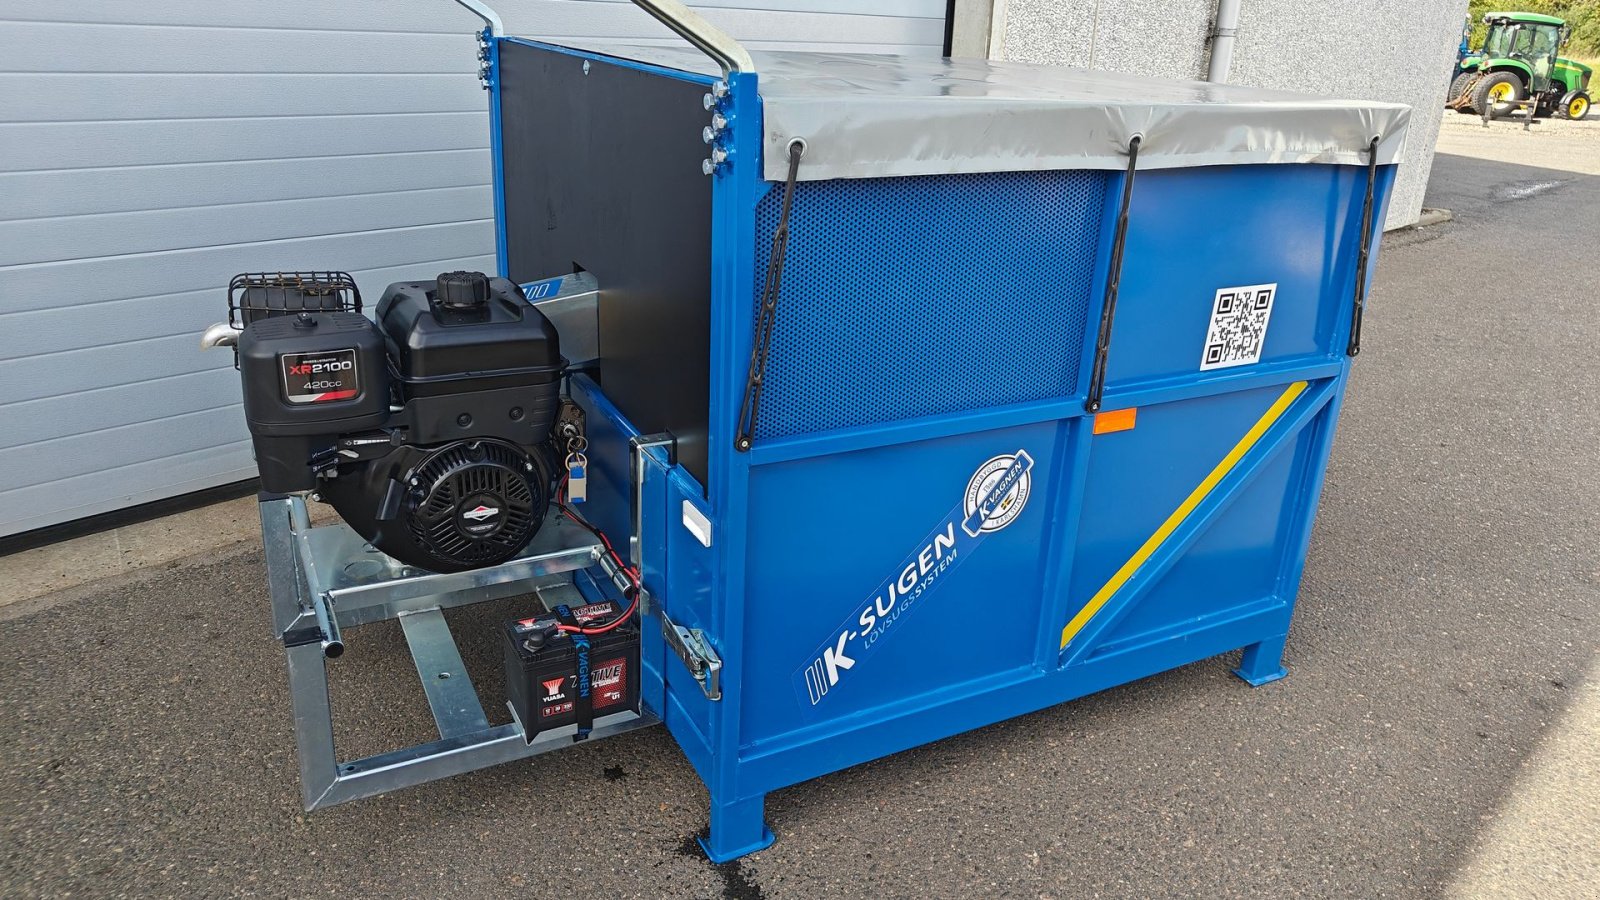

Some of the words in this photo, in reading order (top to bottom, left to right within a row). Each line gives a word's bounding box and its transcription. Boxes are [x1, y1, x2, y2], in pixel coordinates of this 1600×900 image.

[289, 360, 352, 375] XR2100
[303, 380, 342, 389] 420cc
[969, 461, 1002, 502] HANDBYGGD
[979, 460, 1022, 520] K-VAGNEN
[823, 521, 955, 687] K-SUGEN
[864, 548, 958, 650] LÖVSUGSSYSTEM
[575, 638, 590, 697] K-VAGNEN
[542, 693, 566, 703] YUASA
